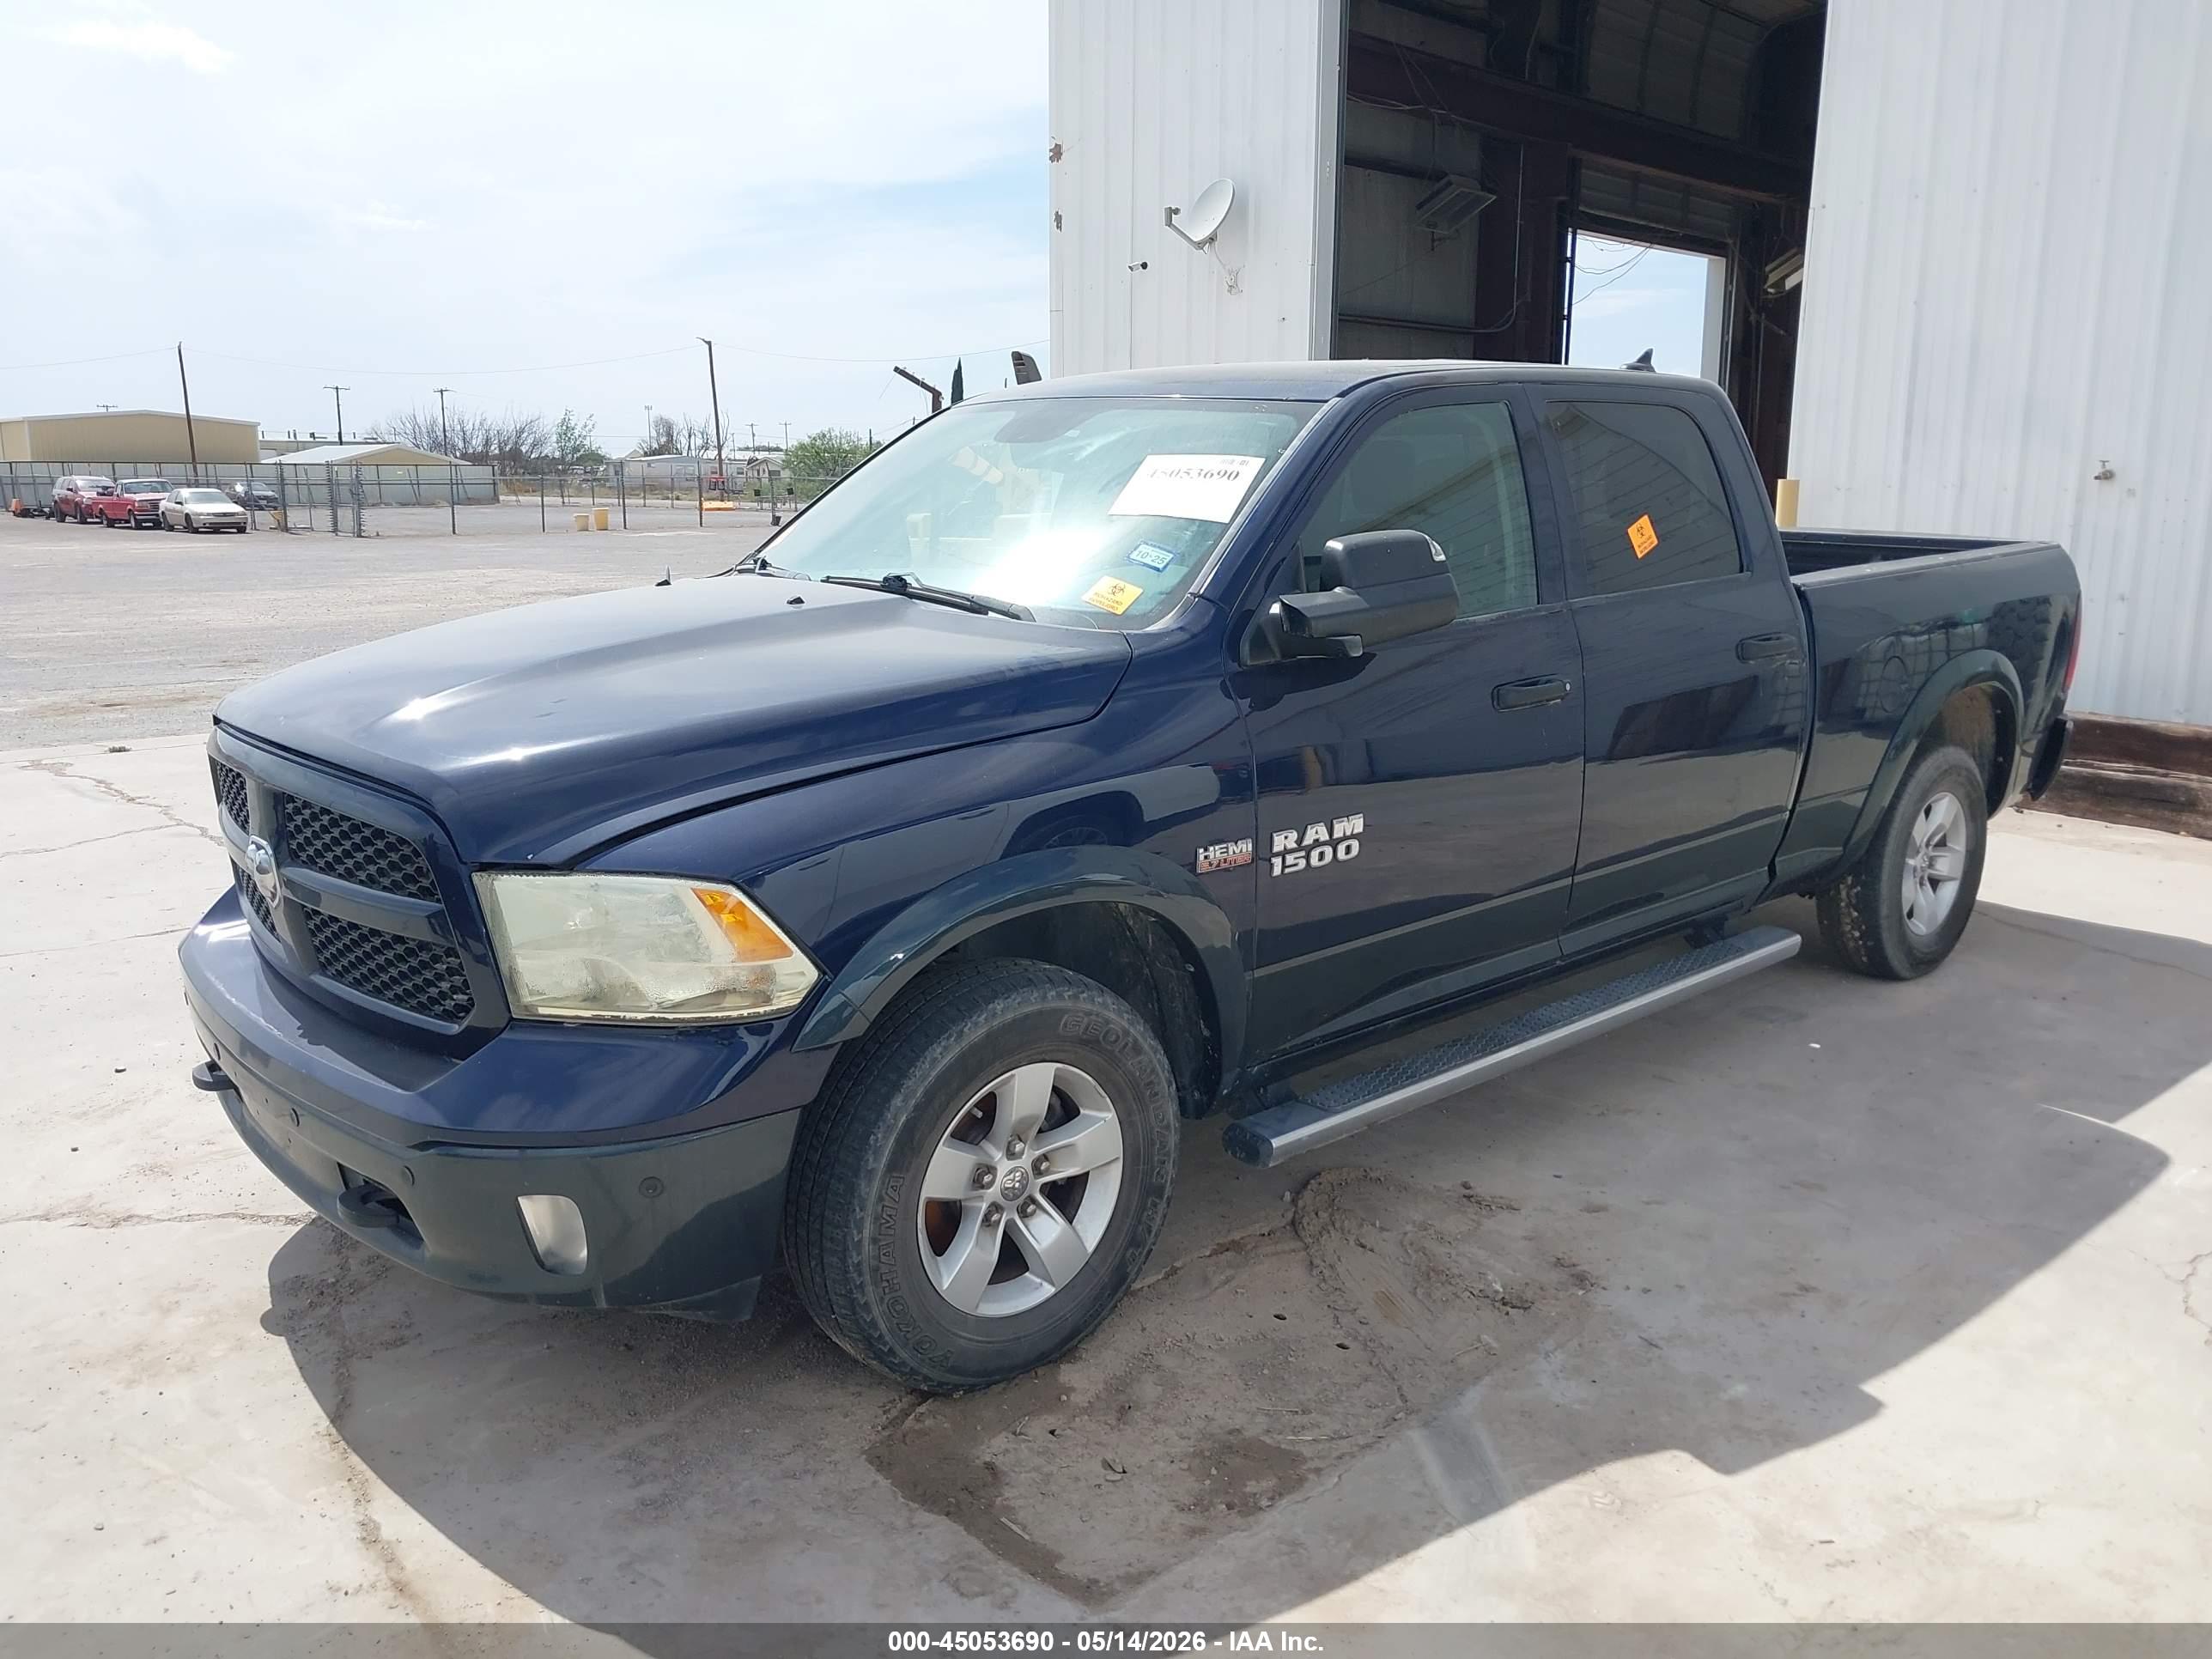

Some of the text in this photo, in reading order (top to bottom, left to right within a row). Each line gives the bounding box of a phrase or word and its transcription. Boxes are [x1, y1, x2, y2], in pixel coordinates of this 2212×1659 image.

[1197, 838, 1252, 862] HEMI
[1272, 813, 1364, 854] RAM
[1271, 839, 1360, 877] 1500
[878, 1175, 955, 1368] YOKOHAMA
